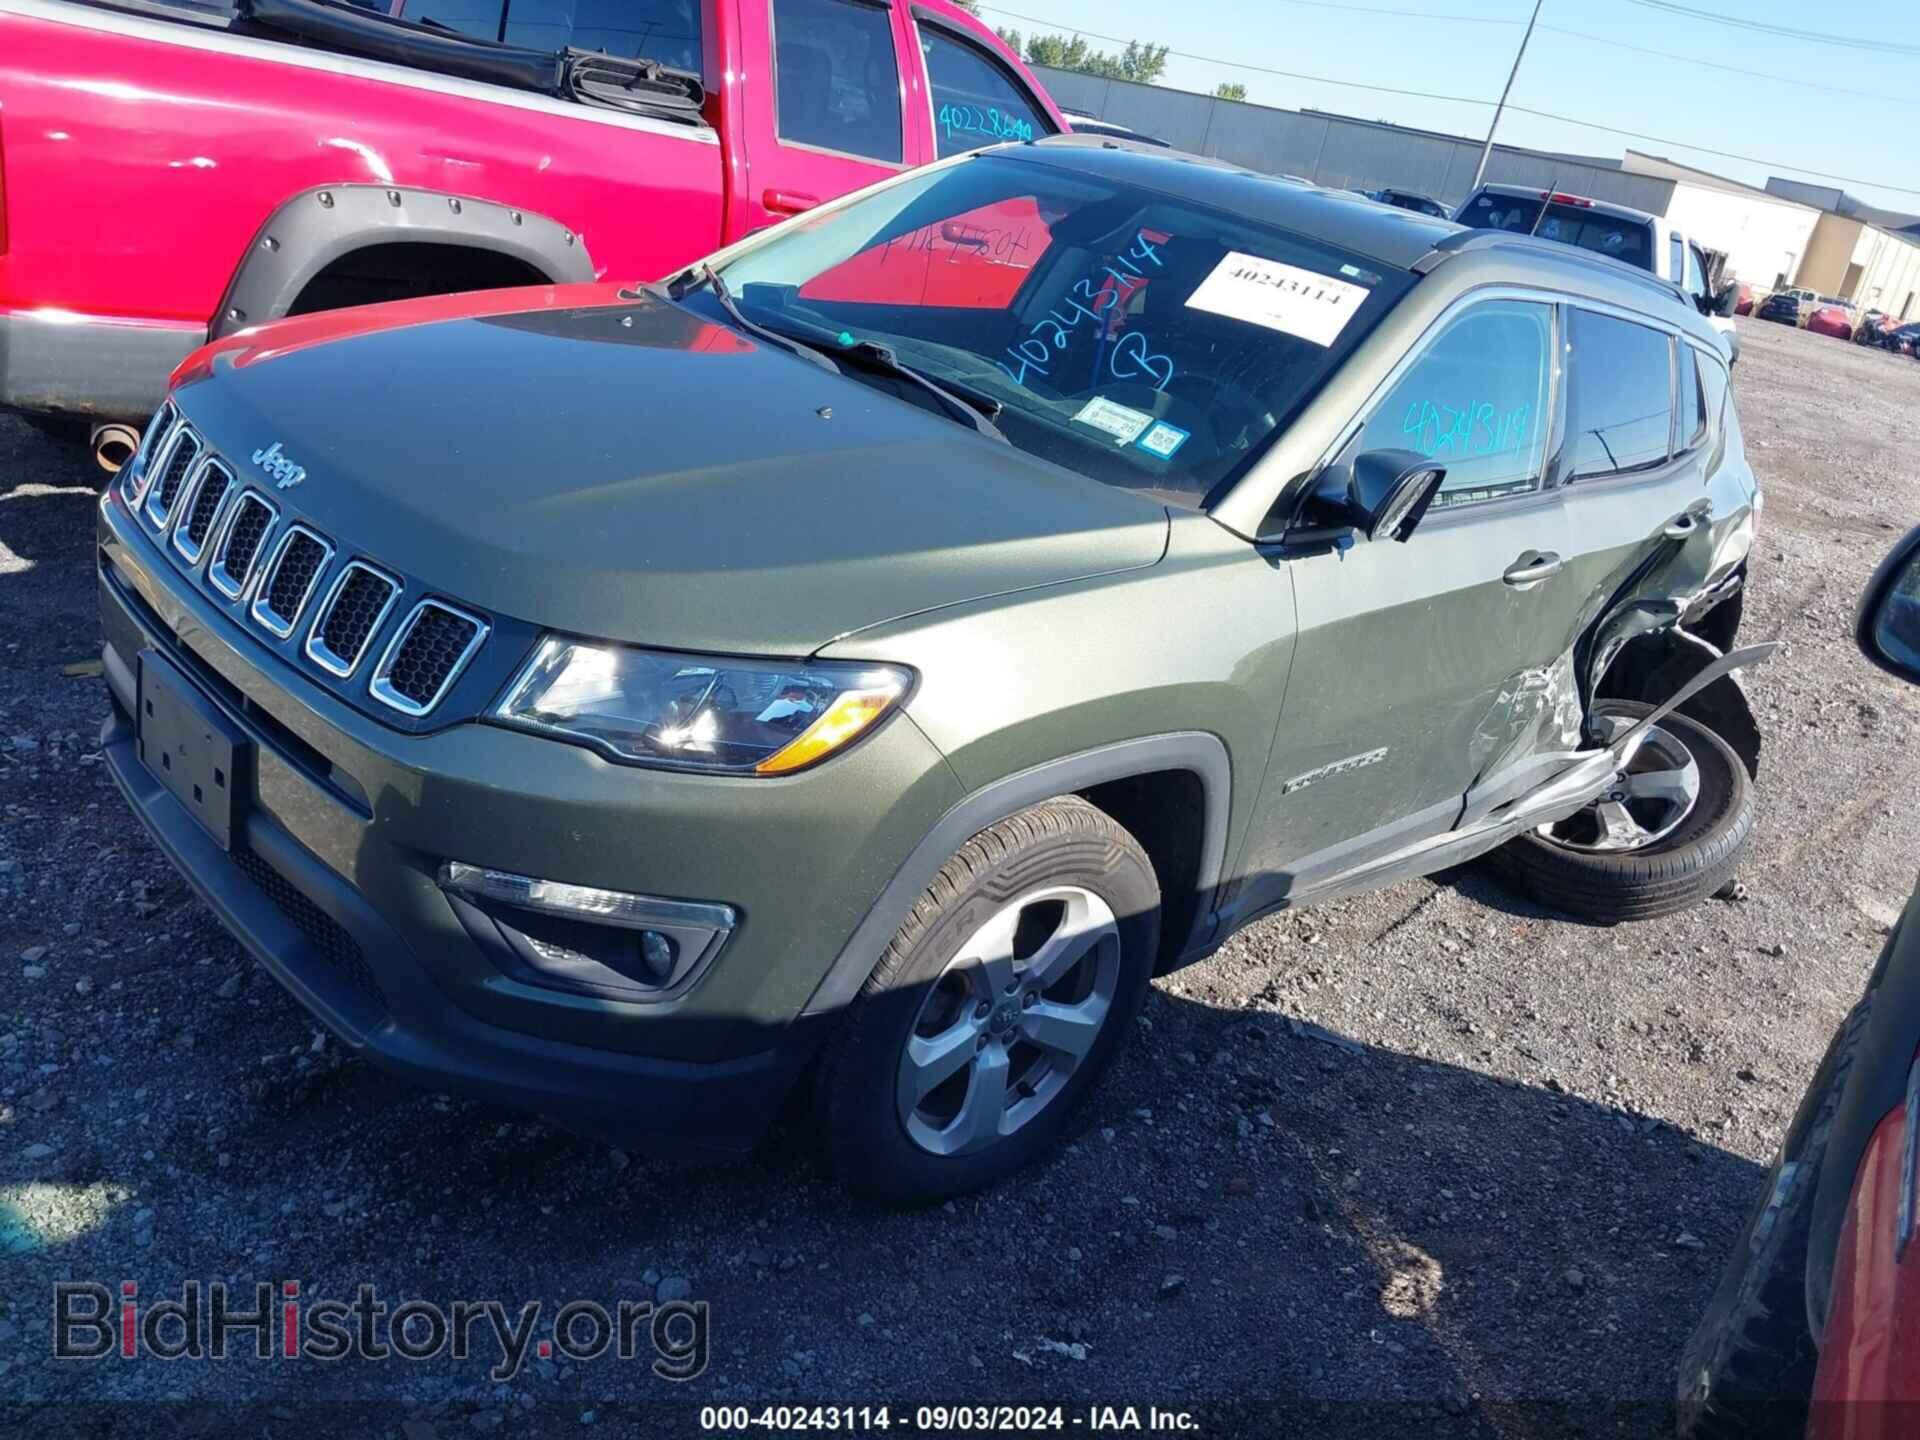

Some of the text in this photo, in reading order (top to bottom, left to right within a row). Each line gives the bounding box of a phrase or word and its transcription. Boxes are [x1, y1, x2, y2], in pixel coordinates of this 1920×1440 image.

[995, 232, 1163, 385] 40243114
[1228, 266, 1342, 306] 40243114
[1403, 399, 1532, 460] 40243114
[252, 441, 306, 489] Jeep
